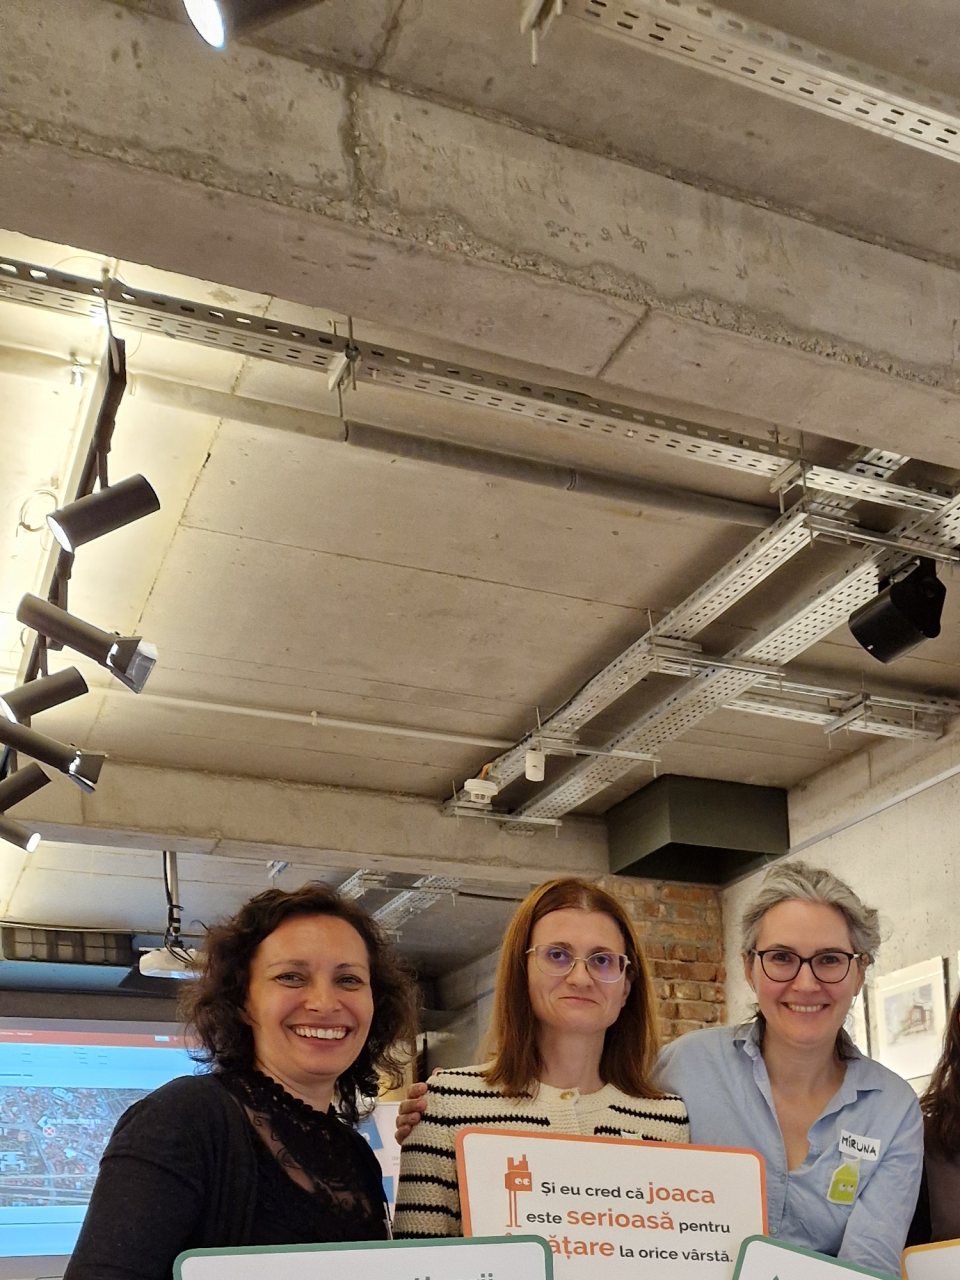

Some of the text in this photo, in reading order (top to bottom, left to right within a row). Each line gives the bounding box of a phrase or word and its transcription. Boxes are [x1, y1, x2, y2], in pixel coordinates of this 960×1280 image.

[541, 1181, 716, 1205] Și eu cred că joaca
[526, 1208, 731, 1234] este serioasă pentru
[619, 1245, 635, 1258] la
[638, 1247, 679, 1260] orice
[681, 1248, 733, 1263] vârstă.
